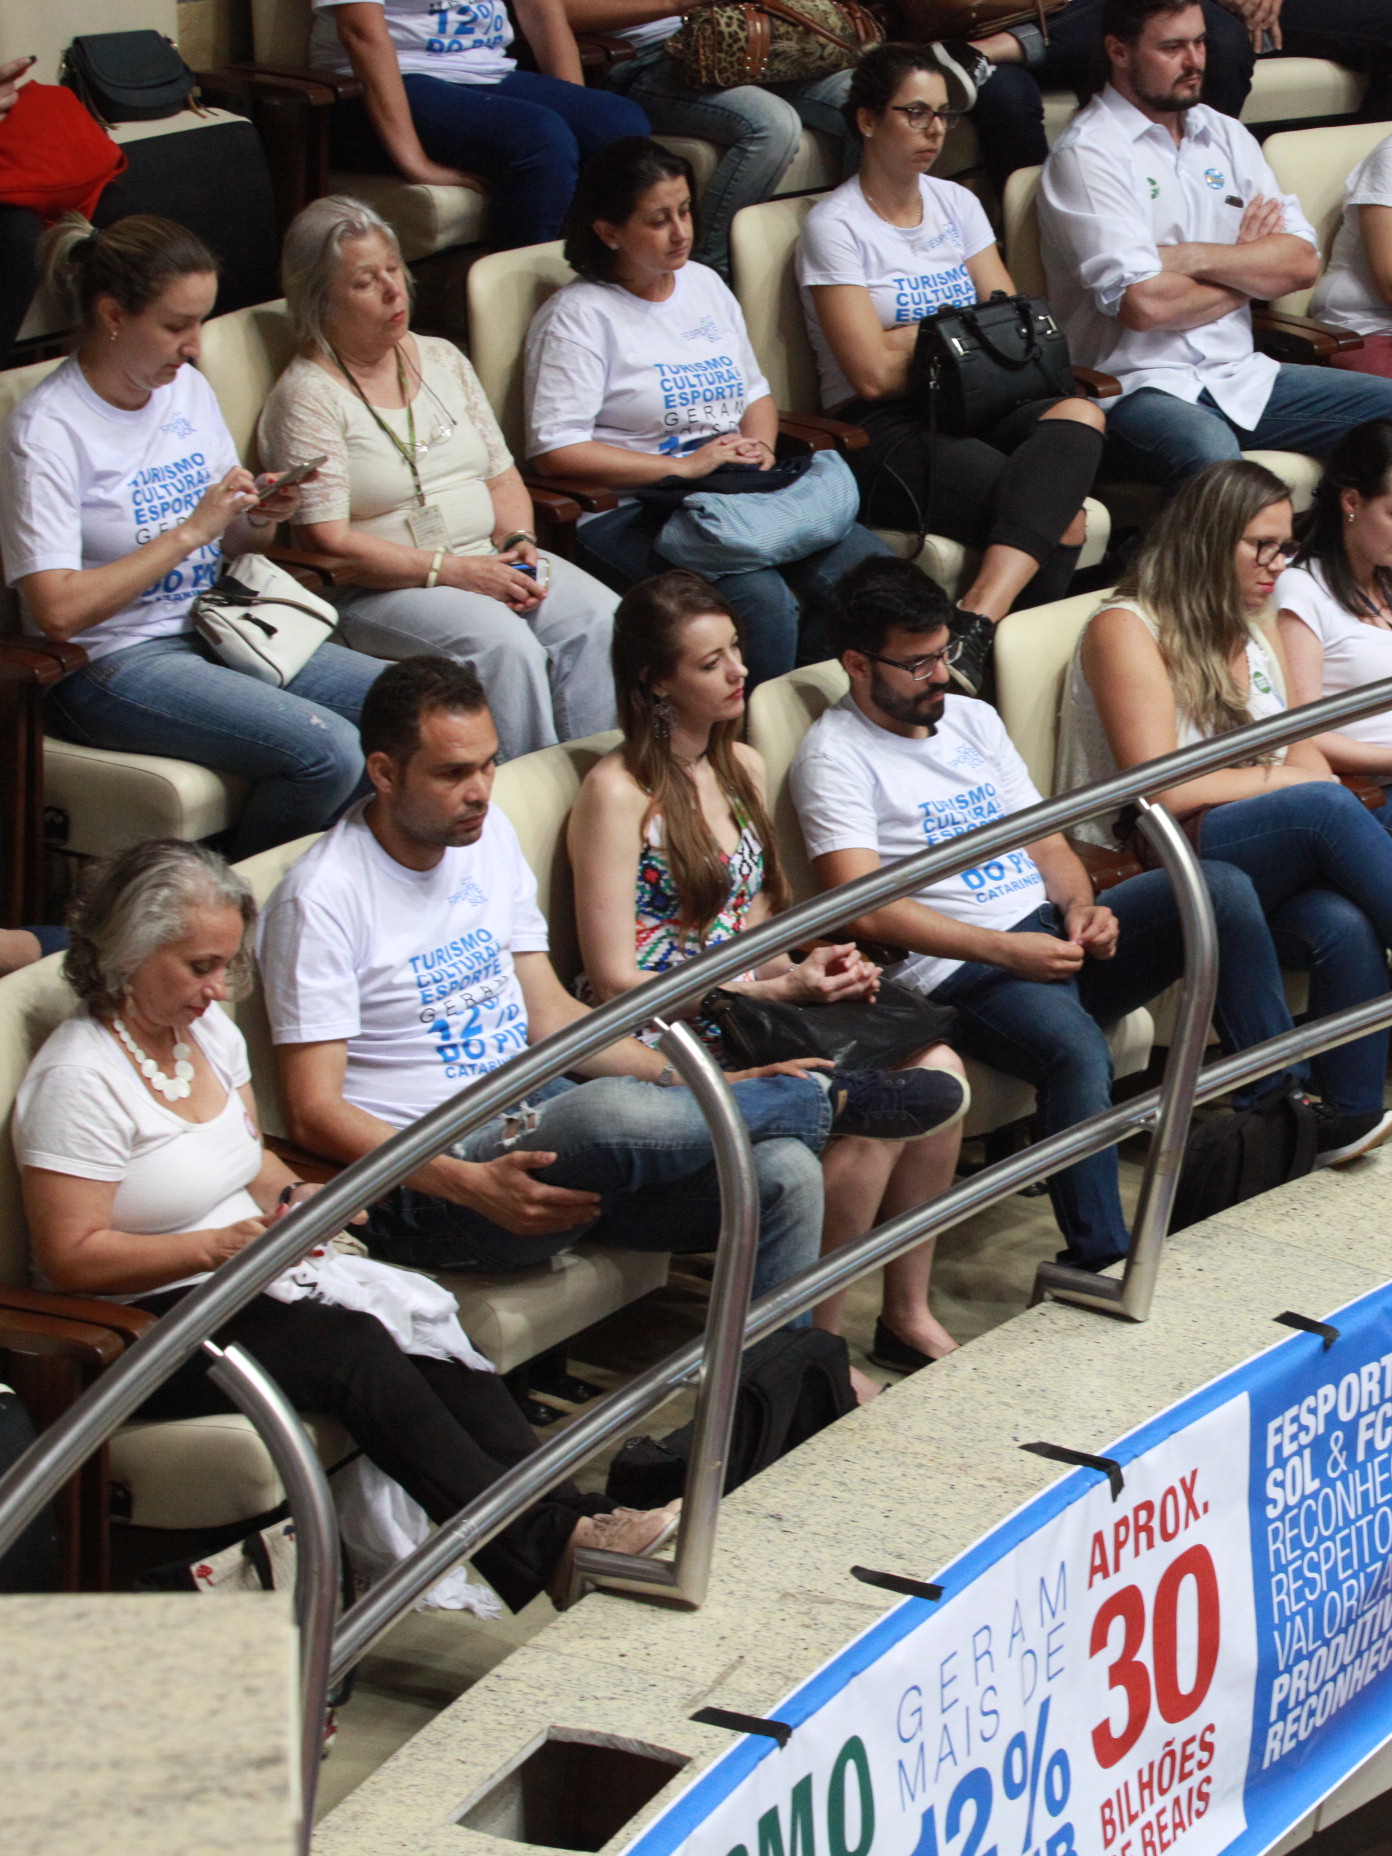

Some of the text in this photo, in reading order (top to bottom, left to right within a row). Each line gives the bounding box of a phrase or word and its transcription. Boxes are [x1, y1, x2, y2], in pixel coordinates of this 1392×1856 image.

[893, 263, 969, 291] TURISMO
[896, 281, 976, 307] CULTURA
[654, 355, 733, 377] TURISMO
[660, 368, 737, 393] CULTURA
[664, 382, 744, 409] ESPORTE
[127, 452, 206, 488] TURISMO
[132, 470, 207, 507] CULTURA
[134, 487, 210, 525] ESPORT
[960, 861, 1006, 891] DO
[409, 928, 492, 974] TURISMO
[416, 945, 499, 989] CULTURA
[419, 958, 502, 1005] ESPORTE
[435, 1038, 486, 1063] DO
[1265, 1444, 1321, 1520] SOL
[1326, 1429, 1349, 1478] &
[1087, 1468, 1209, 1590] APROX.
[897, 1560, 1067, 1743] GERAM
[1088, 1543, 1220, 1770] 30
[897, 1621, 1065, 1812] MAIS DE
[1100, 1722, 1216, 1850] BILHÕES
[1140, 1775, 1213, 1856] REAIS
